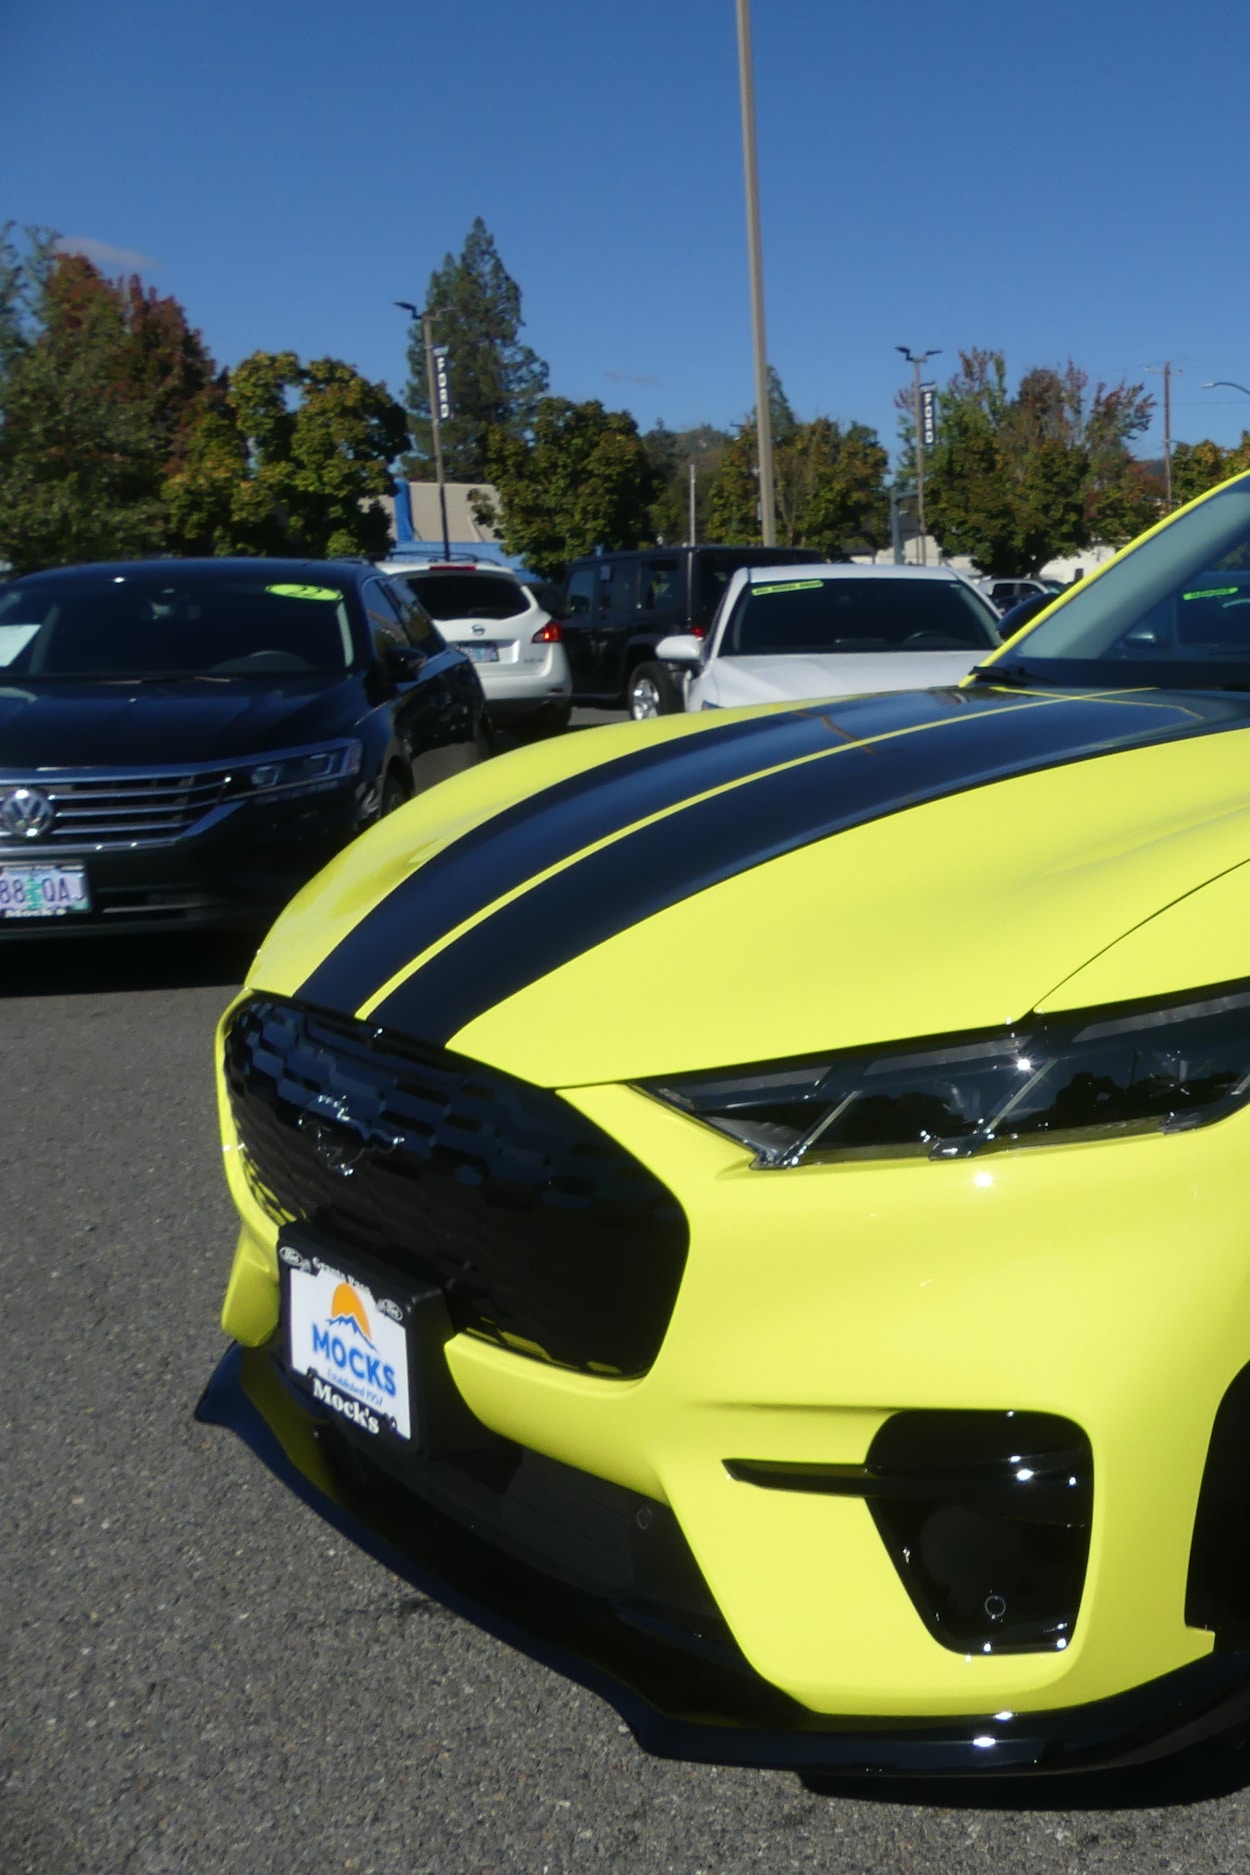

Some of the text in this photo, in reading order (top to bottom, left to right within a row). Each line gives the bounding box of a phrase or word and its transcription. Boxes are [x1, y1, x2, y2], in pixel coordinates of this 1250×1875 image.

[437, 357, 449, 418] FORD
[924, 393, 934, 443] FORD
[312, 1321, 397, 1397] MOCKS
[313, 1378, 380, 1434] Mock's
